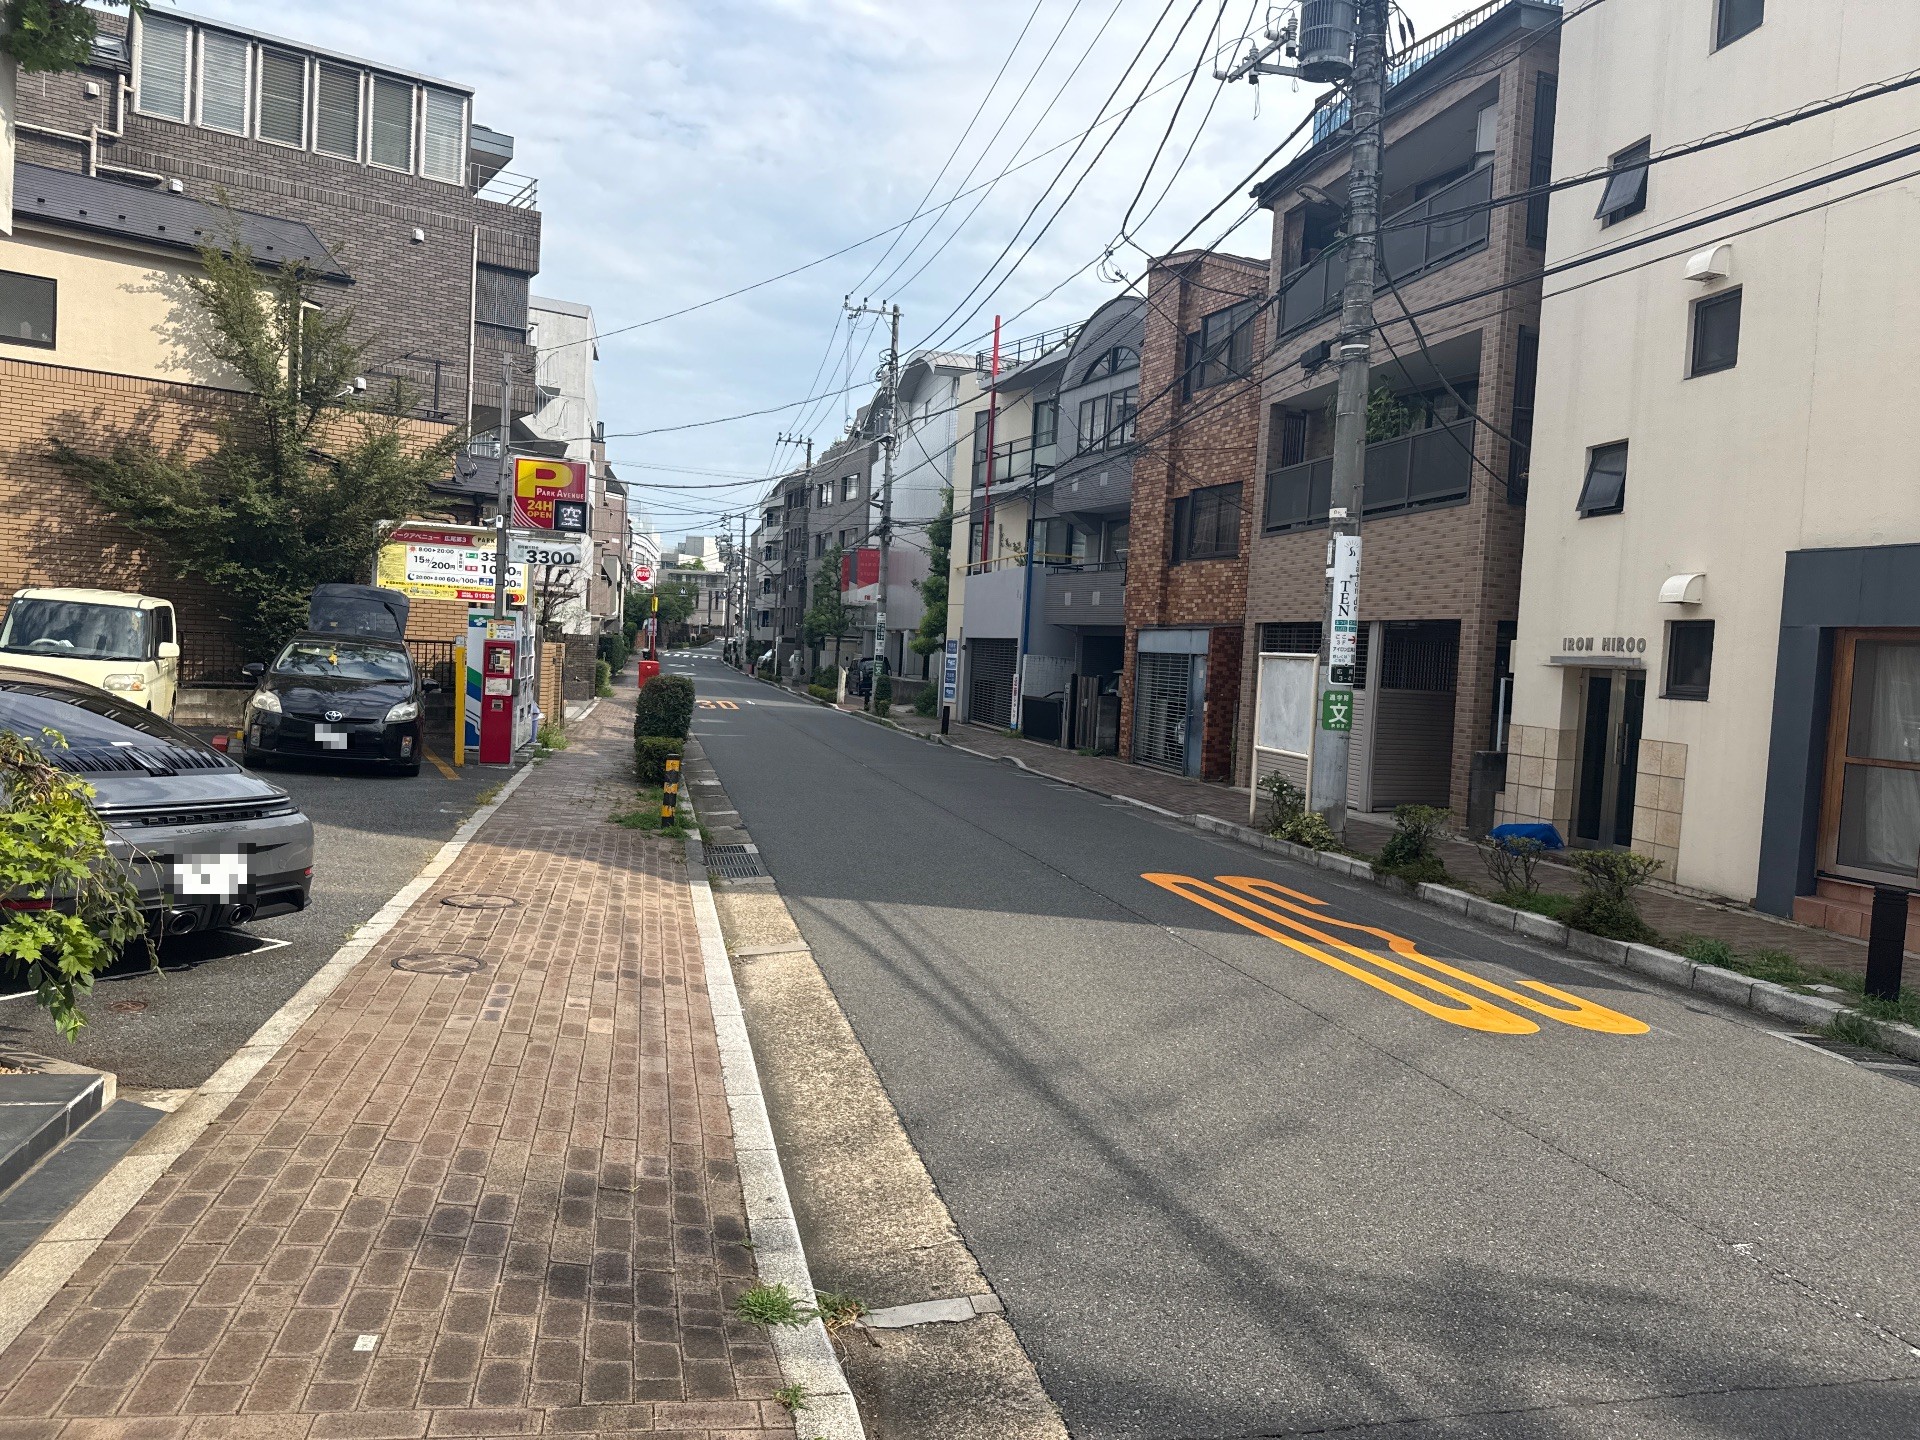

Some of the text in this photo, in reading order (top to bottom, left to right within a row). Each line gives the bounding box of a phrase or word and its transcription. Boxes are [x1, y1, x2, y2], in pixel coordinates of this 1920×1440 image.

[517, 459, 574, 498] P
[536, 487, 584, 500] PARK AVENUE
[527, 500, 552, 511] 24H
[527, 511, 552, 519] OPEN
[1338, 580, 1351, 617] TEN
[1562, 636, 1647, 654] IRON HIROO
[695, 699, 740, 710] 30
[1328, 702, 1349, 724] 文
